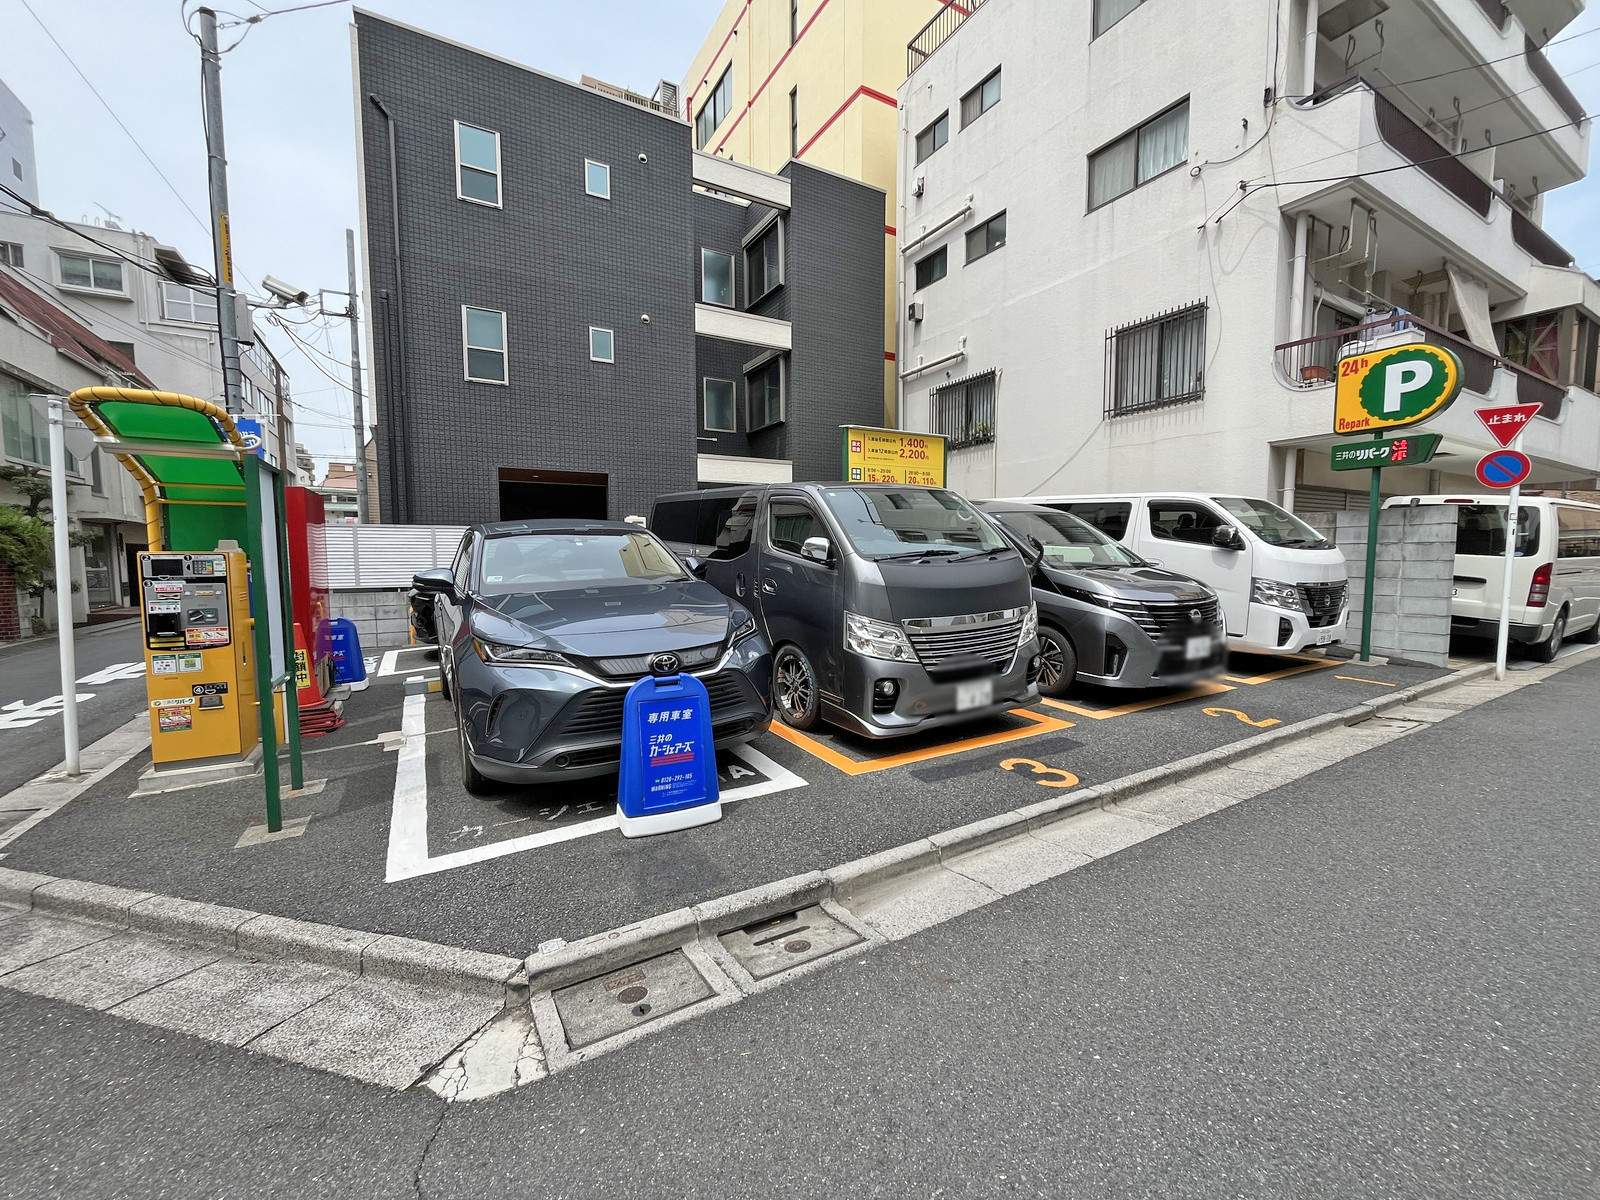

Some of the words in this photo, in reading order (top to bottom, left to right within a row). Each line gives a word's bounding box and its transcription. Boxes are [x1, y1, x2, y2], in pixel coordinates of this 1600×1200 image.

[1341, 358, 1368, 377] 24h
[1383, 360, 1433, 413] P
[1338, 417, 1370, 431] Repark
[1487, 412, 1527, 425] 止まれ
[1335, 446, 1390, 461] 三井のリパーク
[647, 708, 693, 724] 専用車室
[1202, 706, 1282, 728] 2
[649, 733, 673, 745] 三井の
[649, 741, 695, 757] カーシェアーズ
[727, 764, 756, 779] A
[999, 757, 1080, 788] 3
